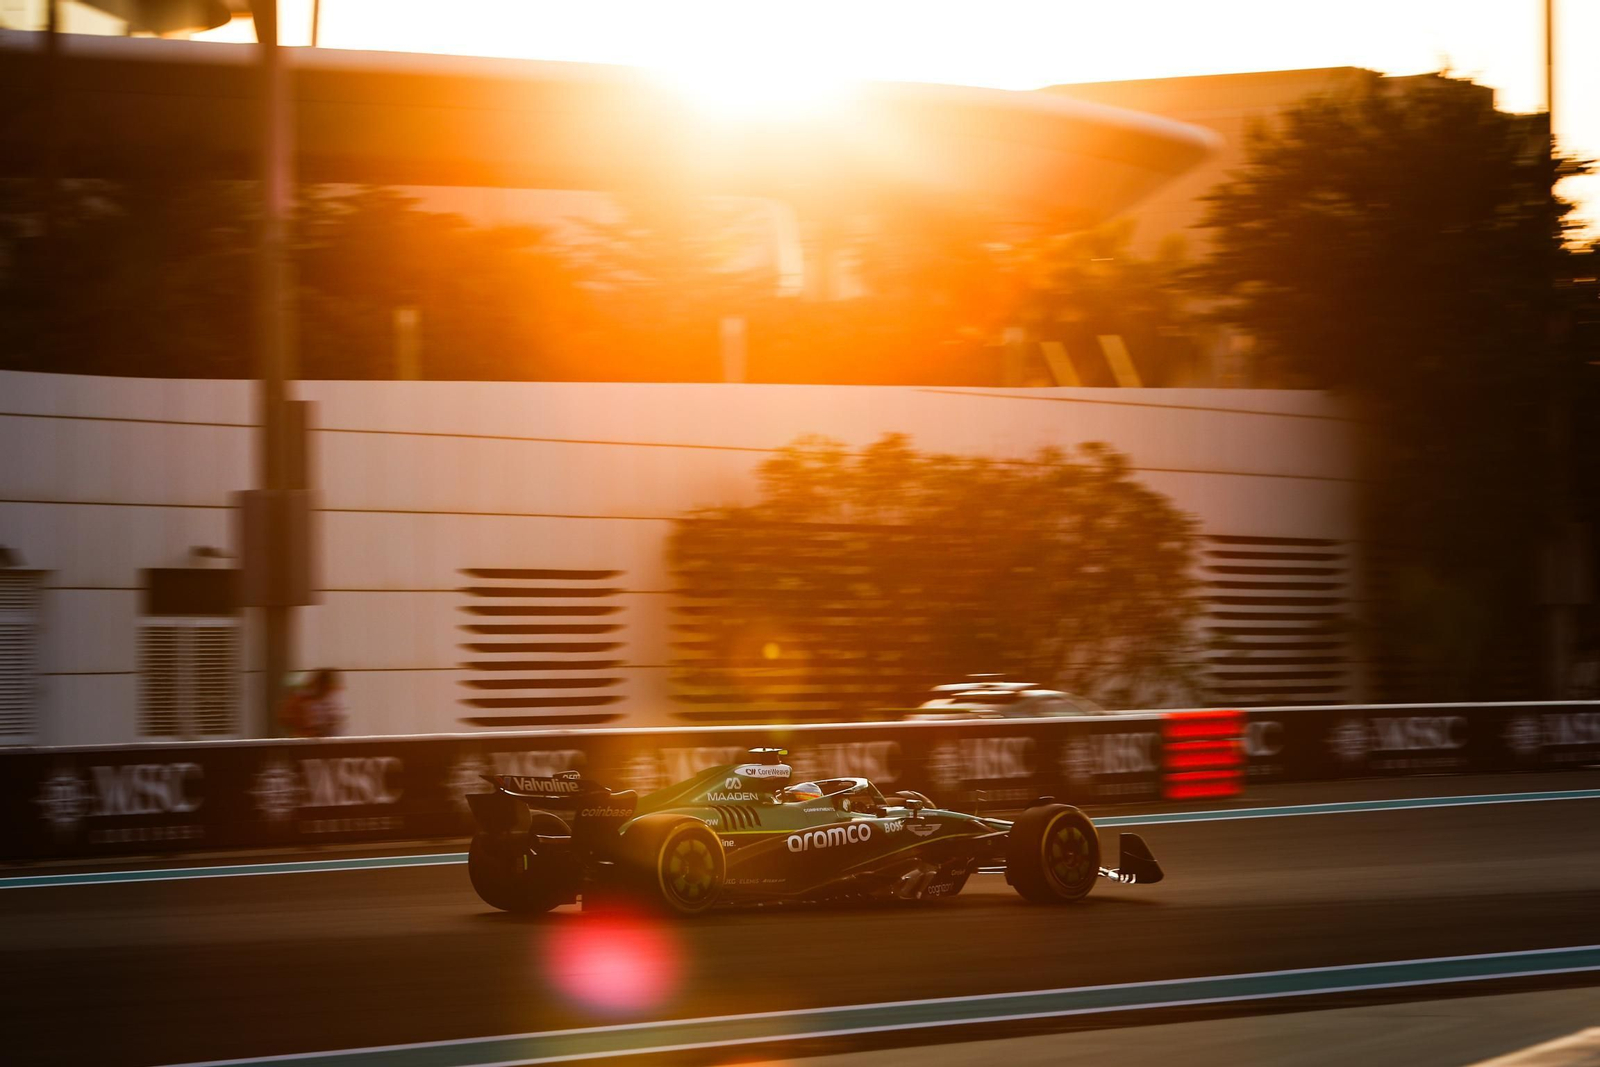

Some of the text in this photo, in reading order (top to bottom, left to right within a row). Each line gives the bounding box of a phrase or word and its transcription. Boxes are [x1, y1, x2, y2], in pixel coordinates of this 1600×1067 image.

[757, 768, 789, 776] CoreWeave
[513, 777, 579, 793] Valvoline
[707, 792, 759, 801] MAADEN
[581, 806, 633, 817] coinbase
[787, 824, 872, 853] aramco
